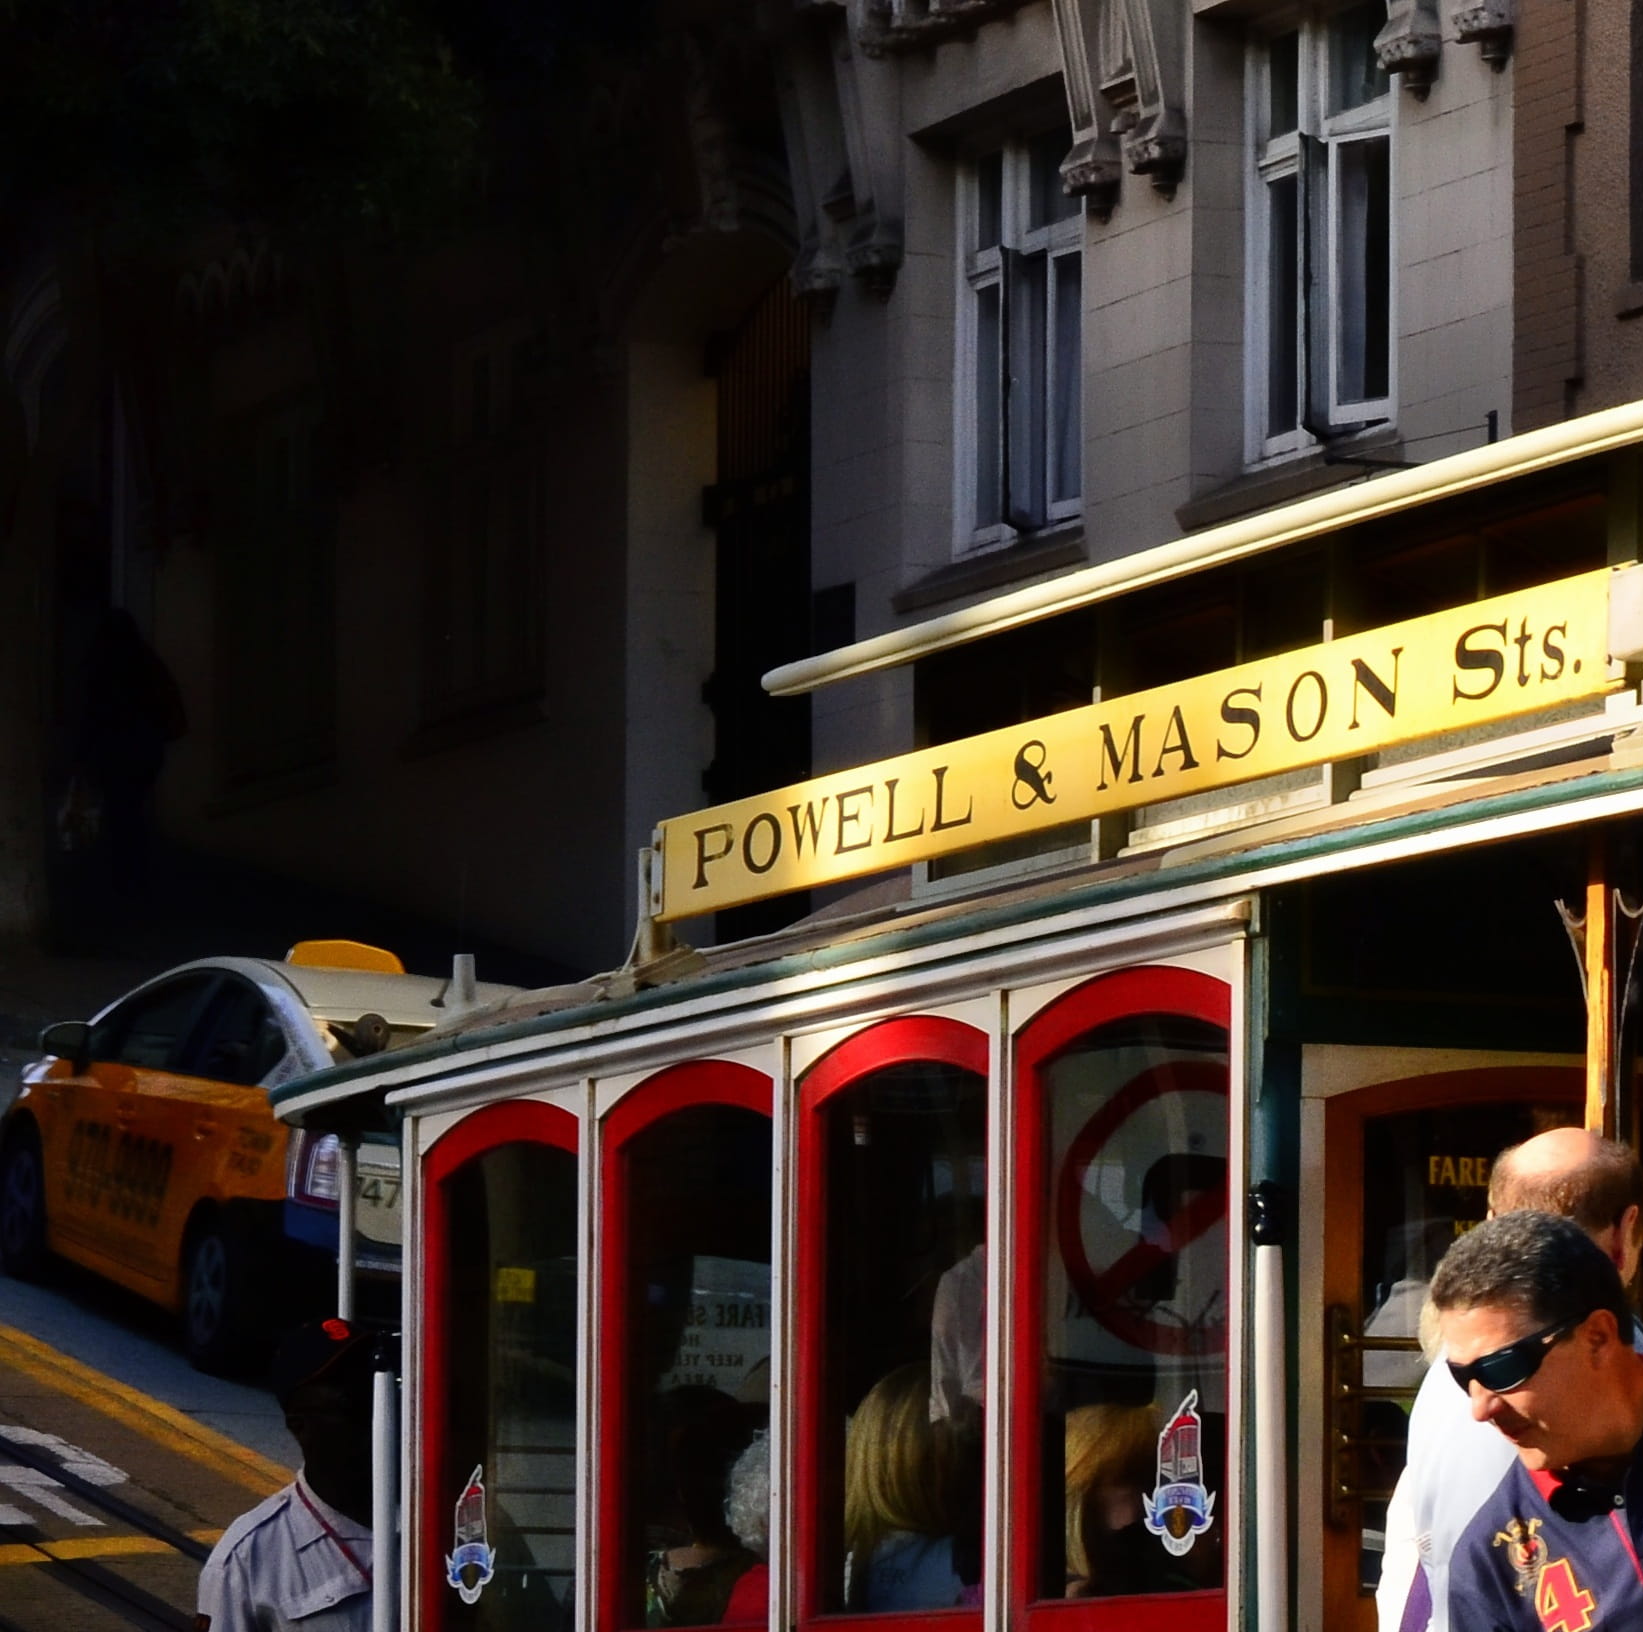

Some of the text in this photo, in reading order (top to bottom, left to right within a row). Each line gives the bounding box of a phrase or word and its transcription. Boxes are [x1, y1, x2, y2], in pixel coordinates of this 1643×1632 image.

[692, 616, 1582, 891] POWELL & MASON Sts.
[1429, 1155, 1488, 1186] FARE
